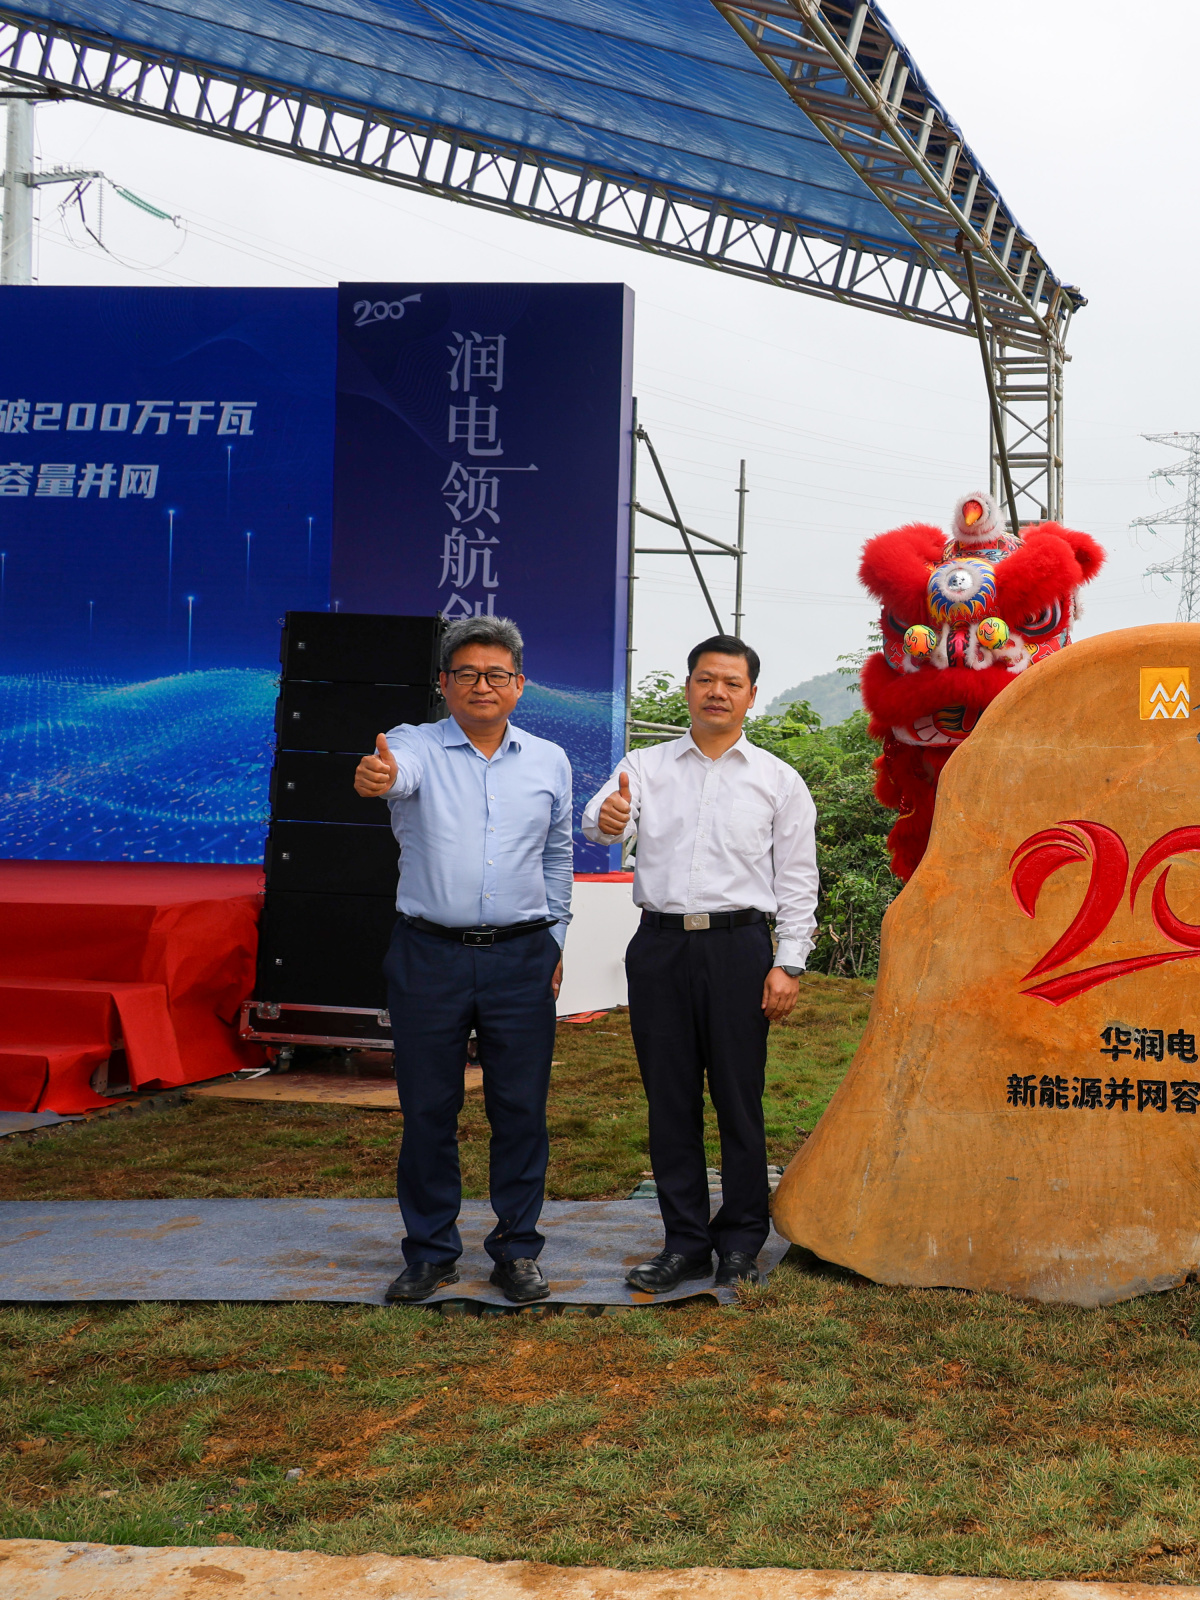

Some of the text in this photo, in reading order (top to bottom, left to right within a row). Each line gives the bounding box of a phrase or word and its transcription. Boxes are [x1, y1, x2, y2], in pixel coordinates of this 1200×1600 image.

[353, 298, 407, 327] 200
[0, 398, 257, 435] 破200万千瓦
[0, 462, 159, 499] 容量并网
